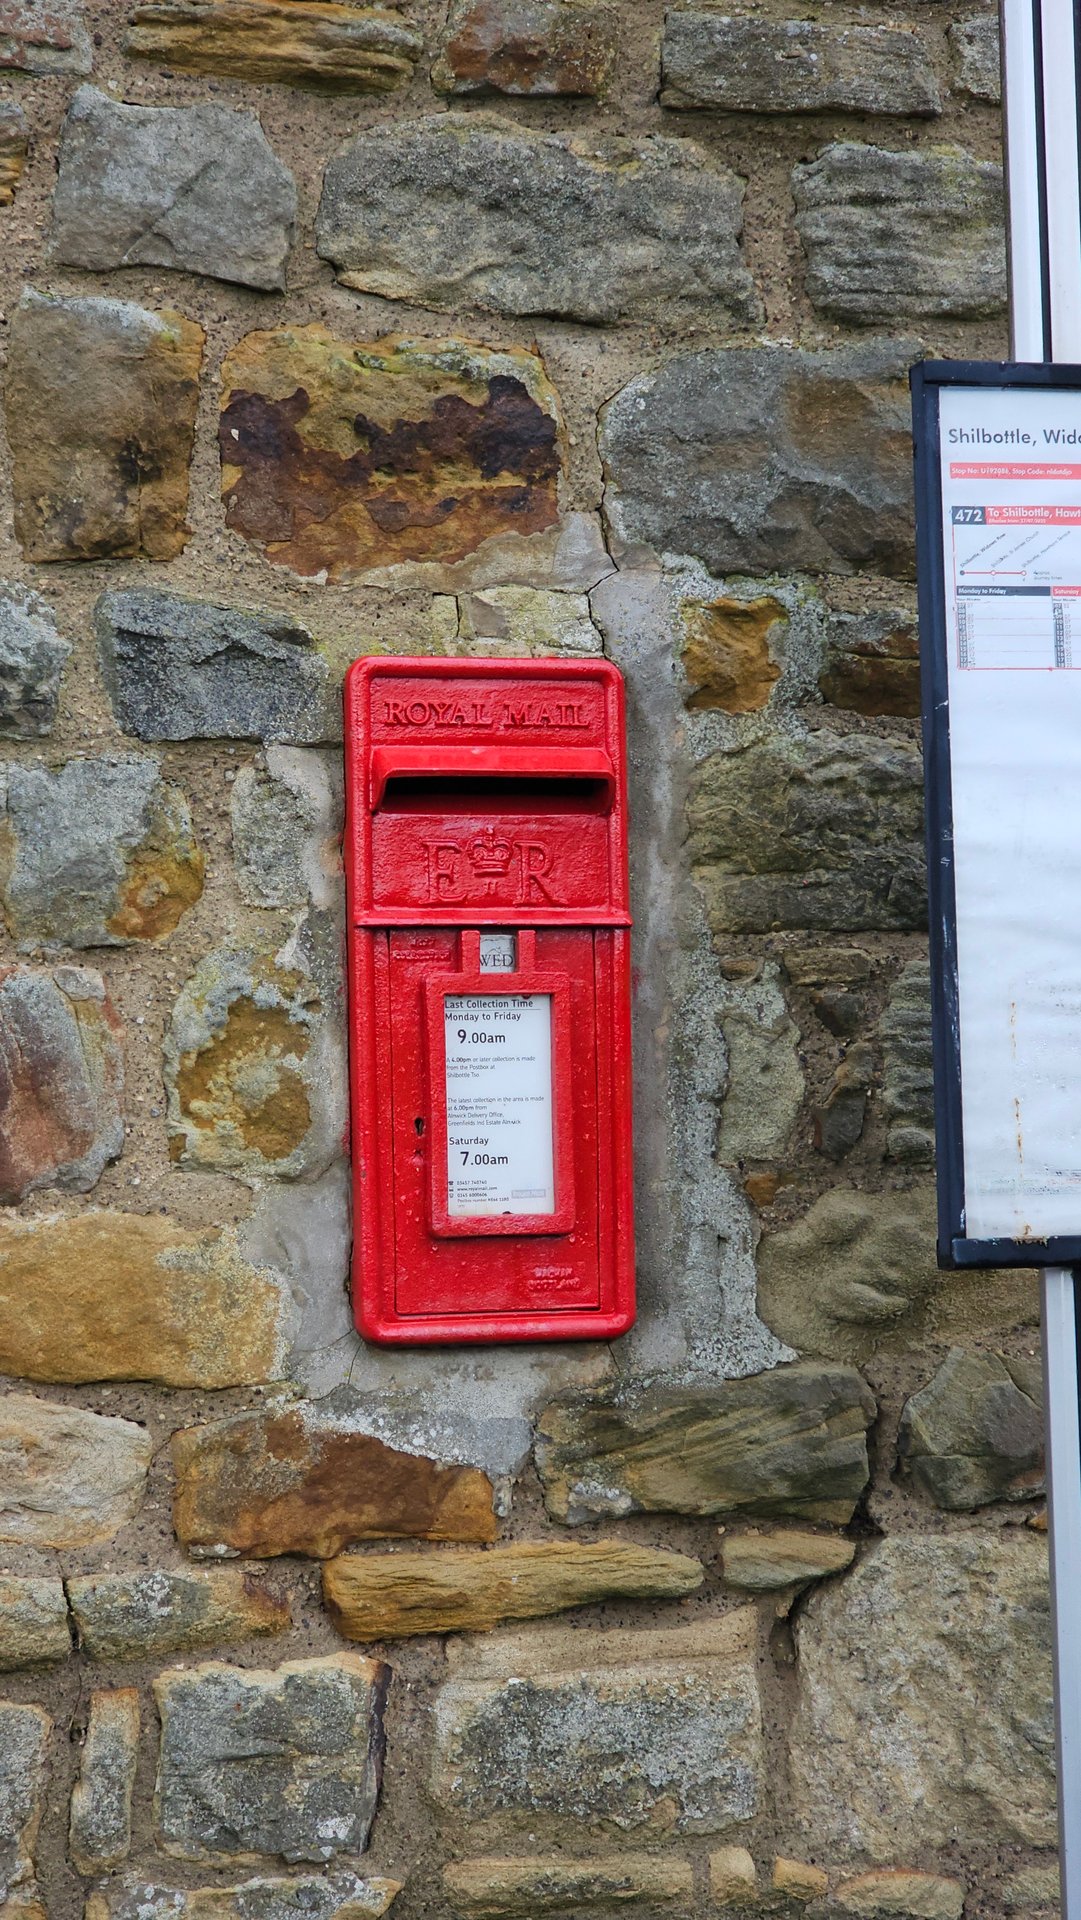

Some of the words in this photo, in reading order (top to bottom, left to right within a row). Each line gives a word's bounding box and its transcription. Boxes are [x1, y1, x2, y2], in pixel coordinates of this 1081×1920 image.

[948, 428, 1037, 447] Shilbottle,
[951, 467, 966, 476] Stop
[1012, 468, 1026, 476] Stop
[954, 509, 983, 522] 472
[988, 508, 999, 517] To
[1002, 507, 1053, 519] Shilbottle,
[958, 587, 981, 595] Monday
[989, 587, 1007, 595] Friday
[1054, 587, 1079, 595] Saturday
[384, 700, 494, 728] ROYAL
[503, 702, 590, 728] MAIL
[480, 954, 514, 967] WED
[445, 1000, 463, 1009] Last
[466, 1000, 509, 1009] Collection
[511, 999, 534, 1008] Time
[445, 1013, 479, 1022] Monday
[482, 1013, 491, 1021] to
[494, 1012, 521, 1021] Friday
[457, 1029, 506, 1044] 9.00am
[449, 1137, 489, 1146] Saturday
[460, 1151, 508, 1166] 7.00am
